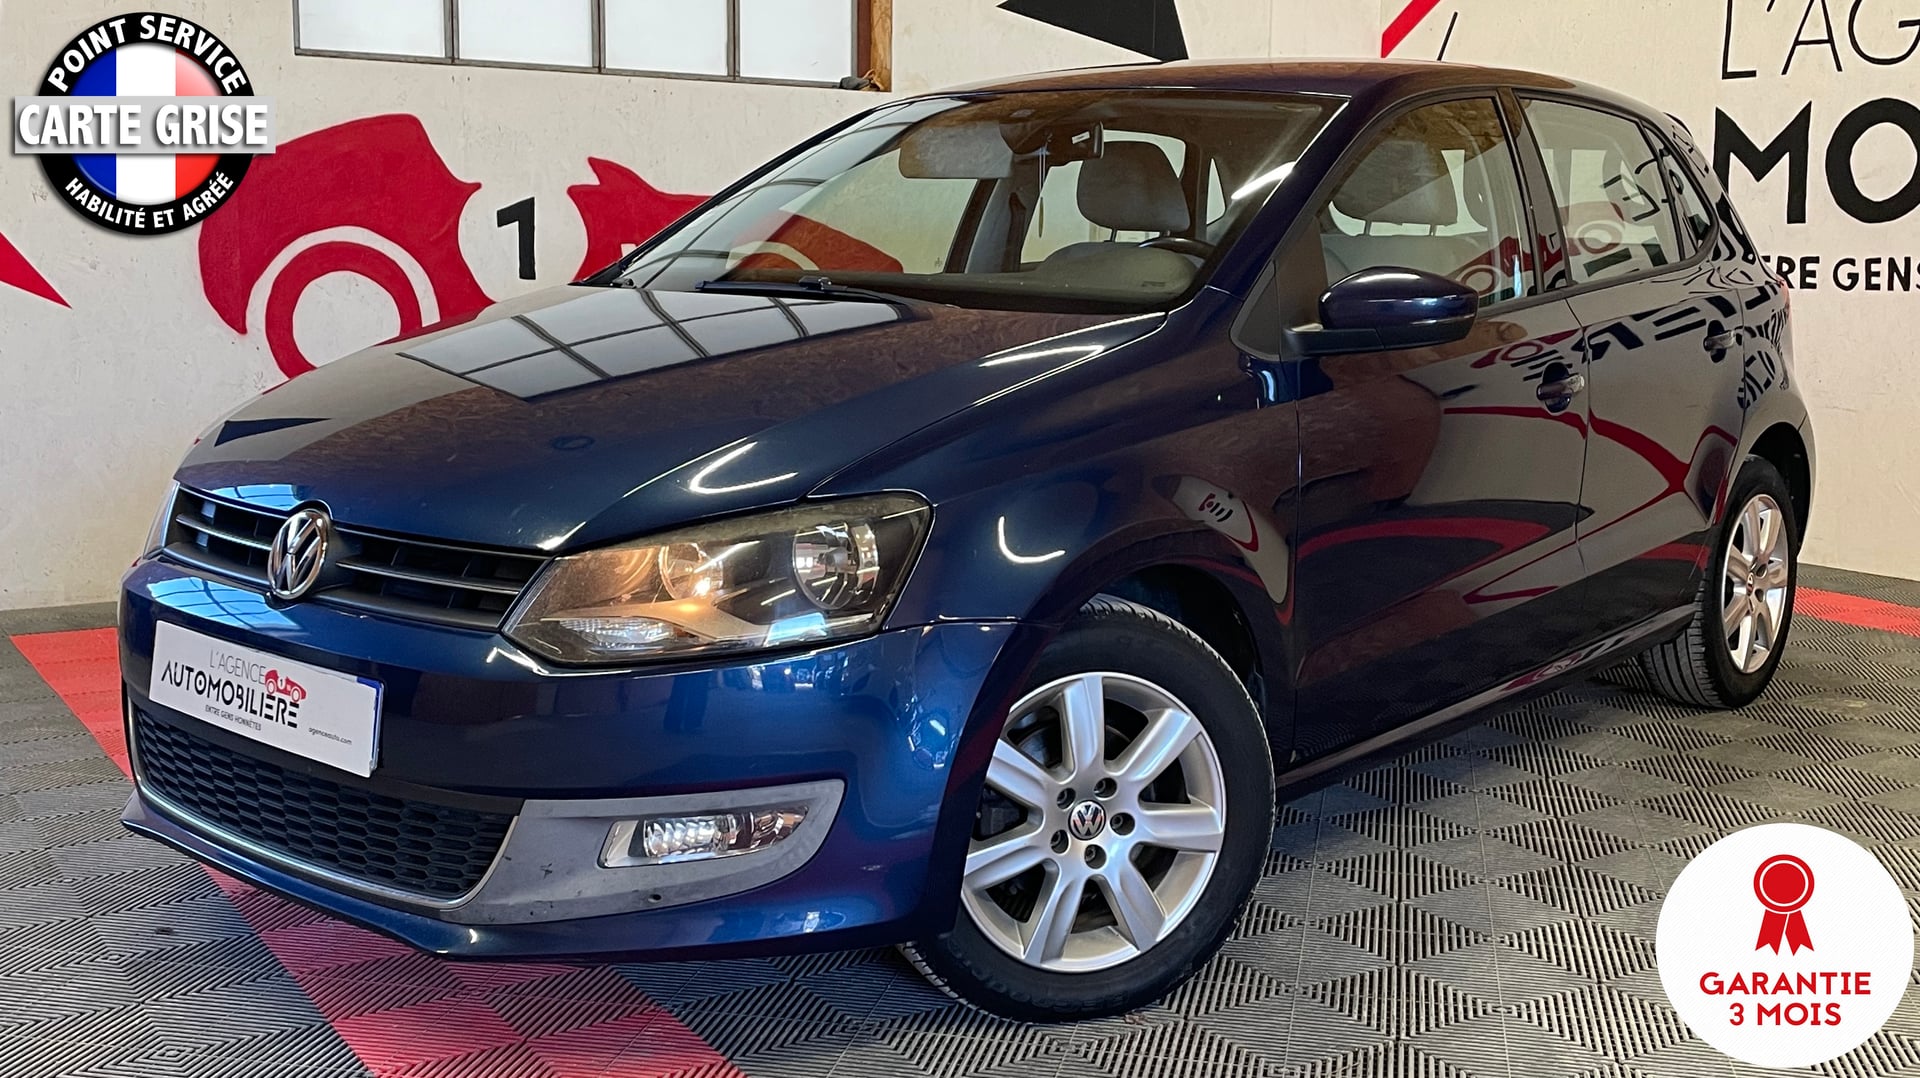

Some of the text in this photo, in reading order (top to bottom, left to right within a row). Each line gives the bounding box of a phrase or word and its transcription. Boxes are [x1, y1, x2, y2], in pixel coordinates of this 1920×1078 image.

[496, 196, 536, 280] 1
[1760, 255, 1920, 292] RE GEN
[268, 510, 328, 599] VW
[209, 649, 267, 685] L'AGENCE
[1069, 800, 1106, 840] VW
